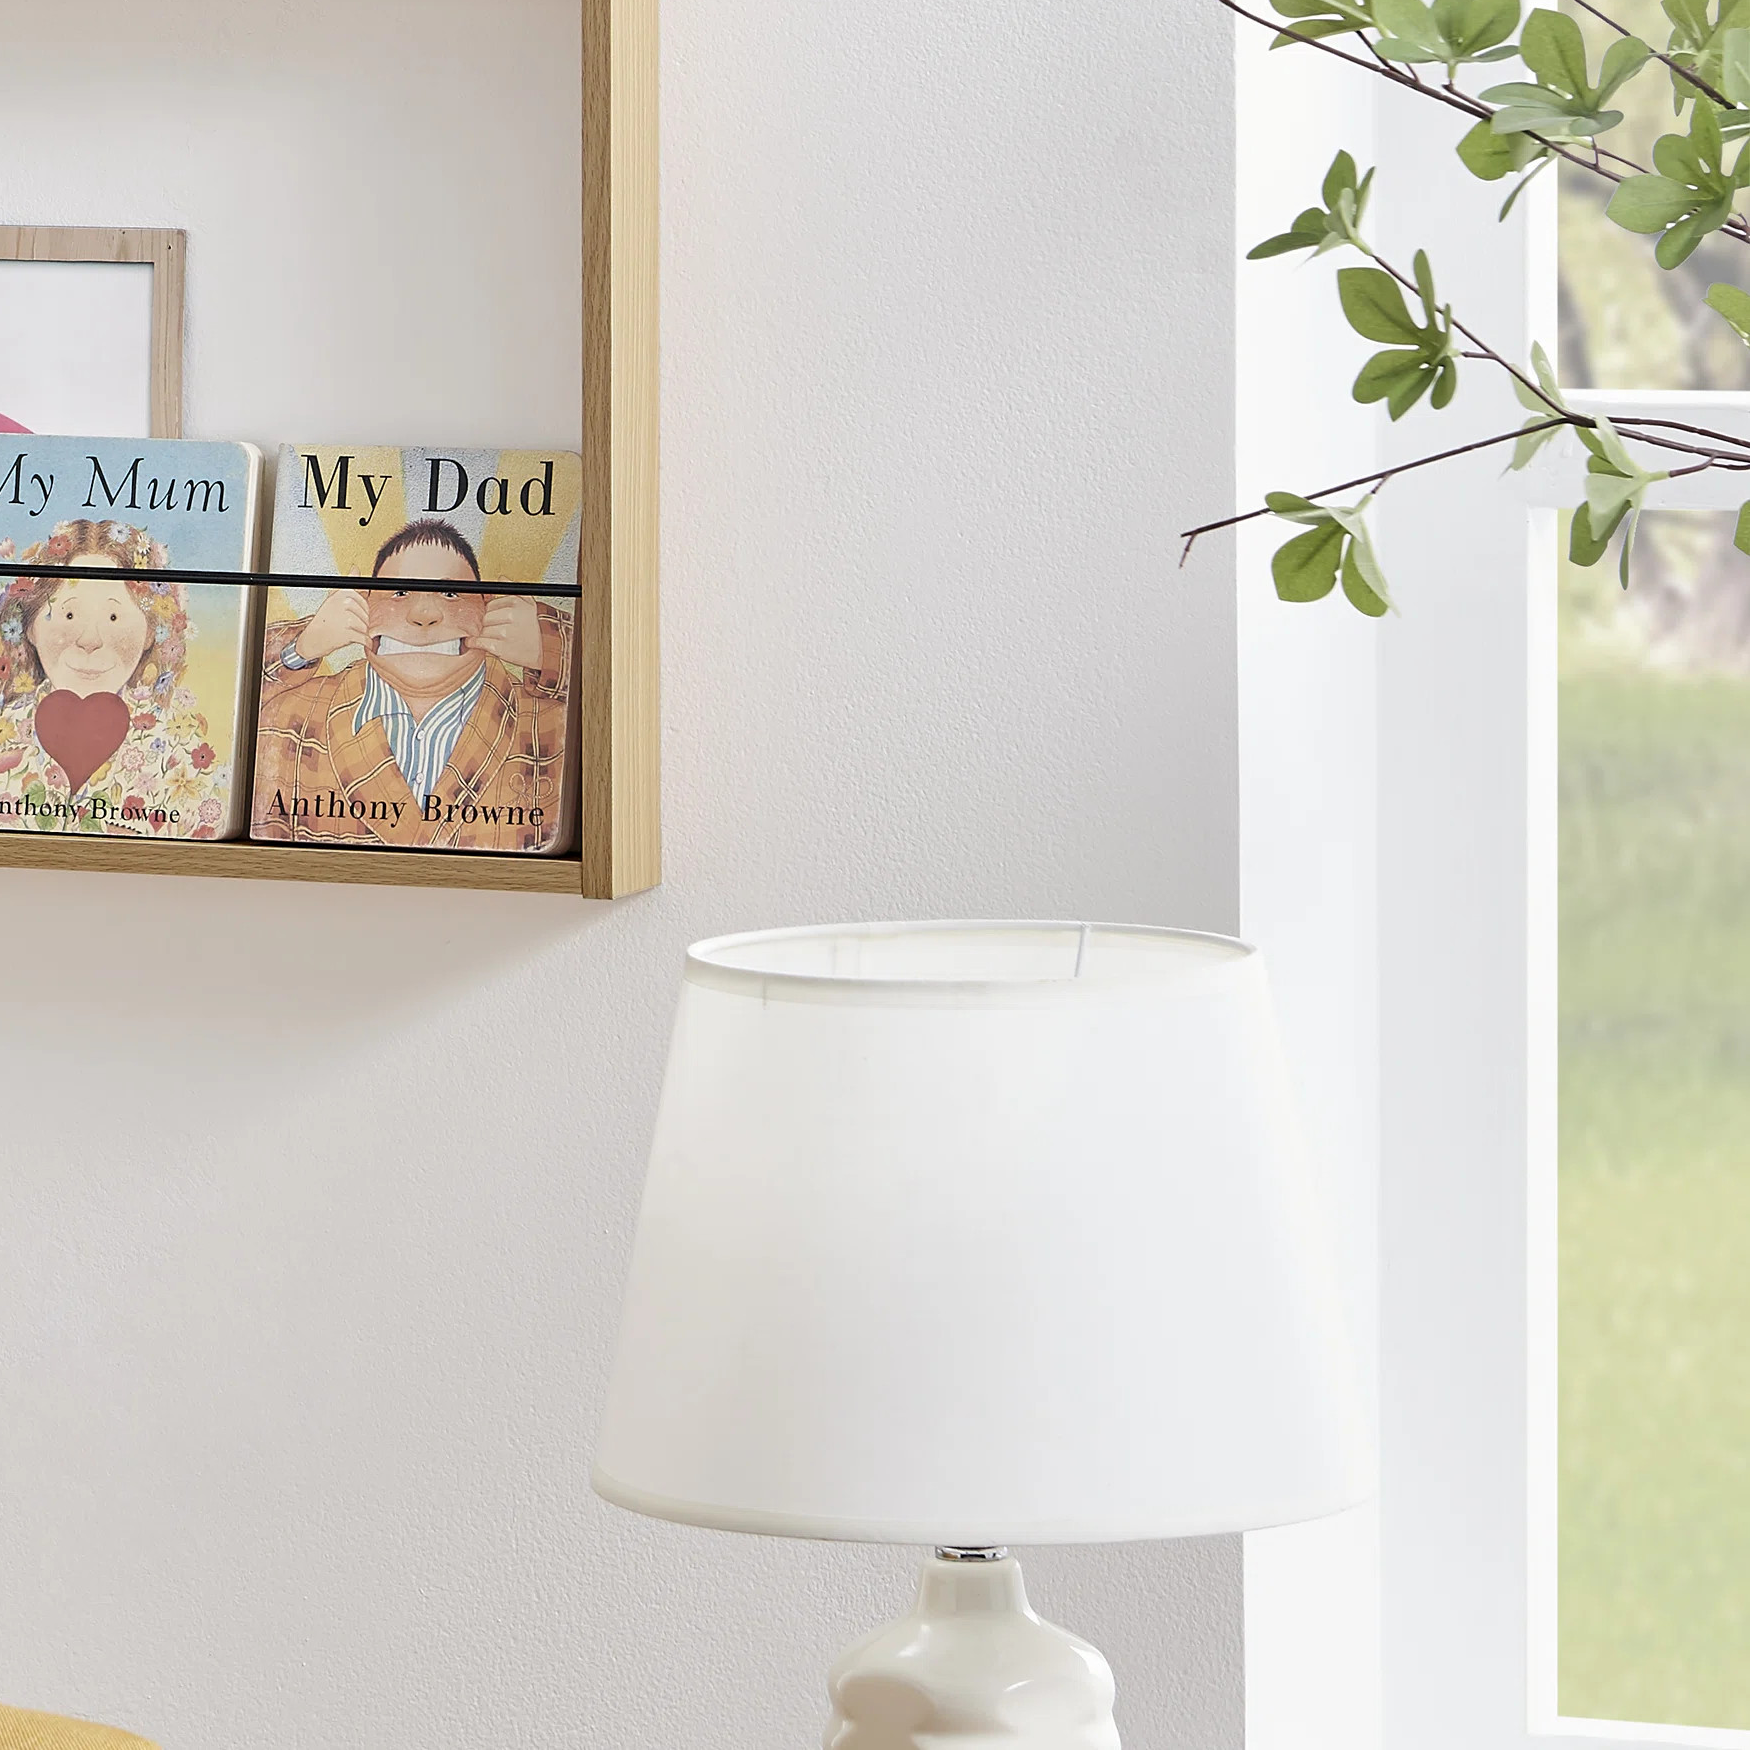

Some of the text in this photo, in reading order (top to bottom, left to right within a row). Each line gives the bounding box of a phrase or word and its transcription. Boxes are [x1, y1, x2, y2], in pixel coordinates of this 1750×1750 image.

[81, 455, 230, 513] Mum
[297, 454, 557, 526] My Dad
[90, 798, 181, 824] Browne
[266, 788, 545, 828] Anthony Browne
